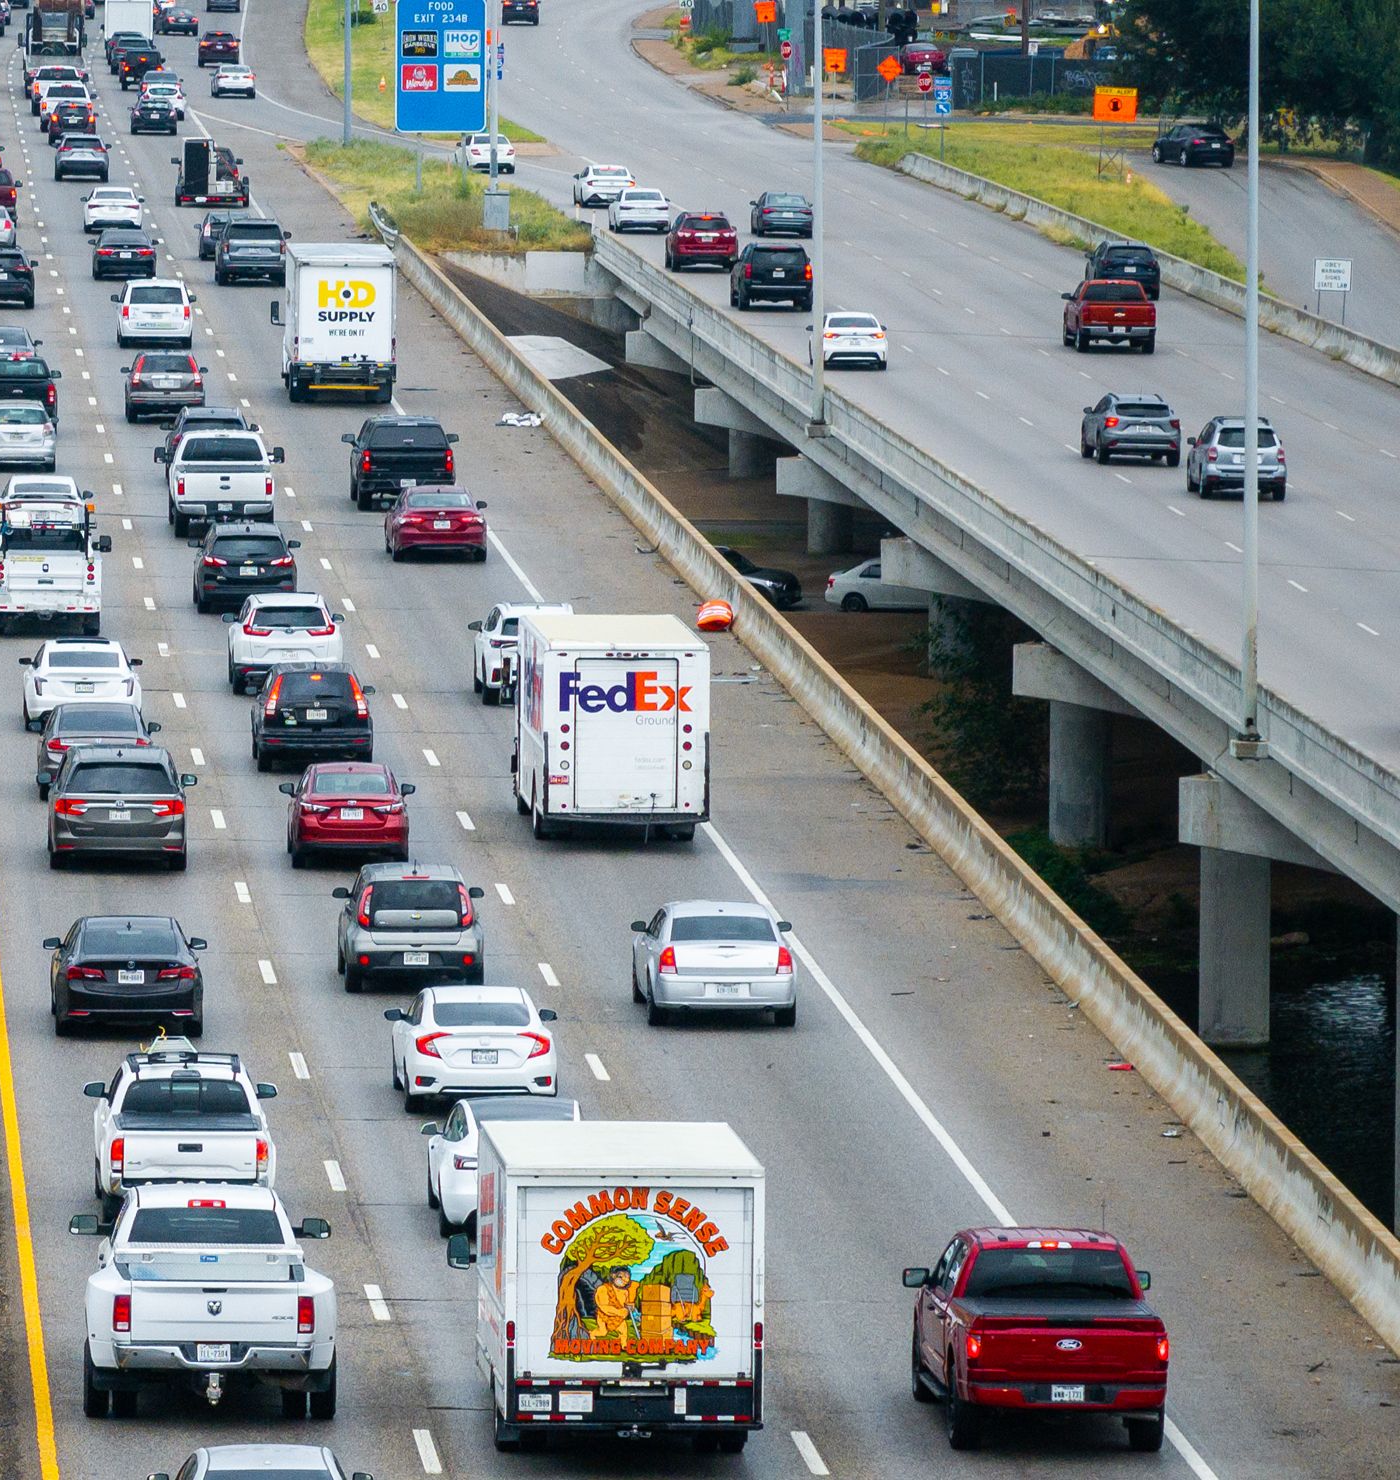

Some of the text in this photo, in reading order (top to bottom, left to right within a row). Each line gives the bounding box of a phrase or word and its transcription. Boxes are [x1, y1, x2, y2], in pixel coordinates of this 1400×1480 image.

[375, 3, 388, 12] 40
[428, 1, 454, 11] FOOD
[414, 13, 468, 23] EXIT 234B
[406, 78, 434, 90] Wendy's
[918, 78, 931, 86] STOP
[938, 91, 949, 100] 35
[318, 311, 375, 322] SUPPLY
[559, 671, 693, 713] FedEx
[635, 714, 676, 726] Ground
[540, 1186, 651, 1256] COMMON
[652, 1190, 730, 1258] SENSE
[553, 1338, 711, 1356] MOVING COMPANY
